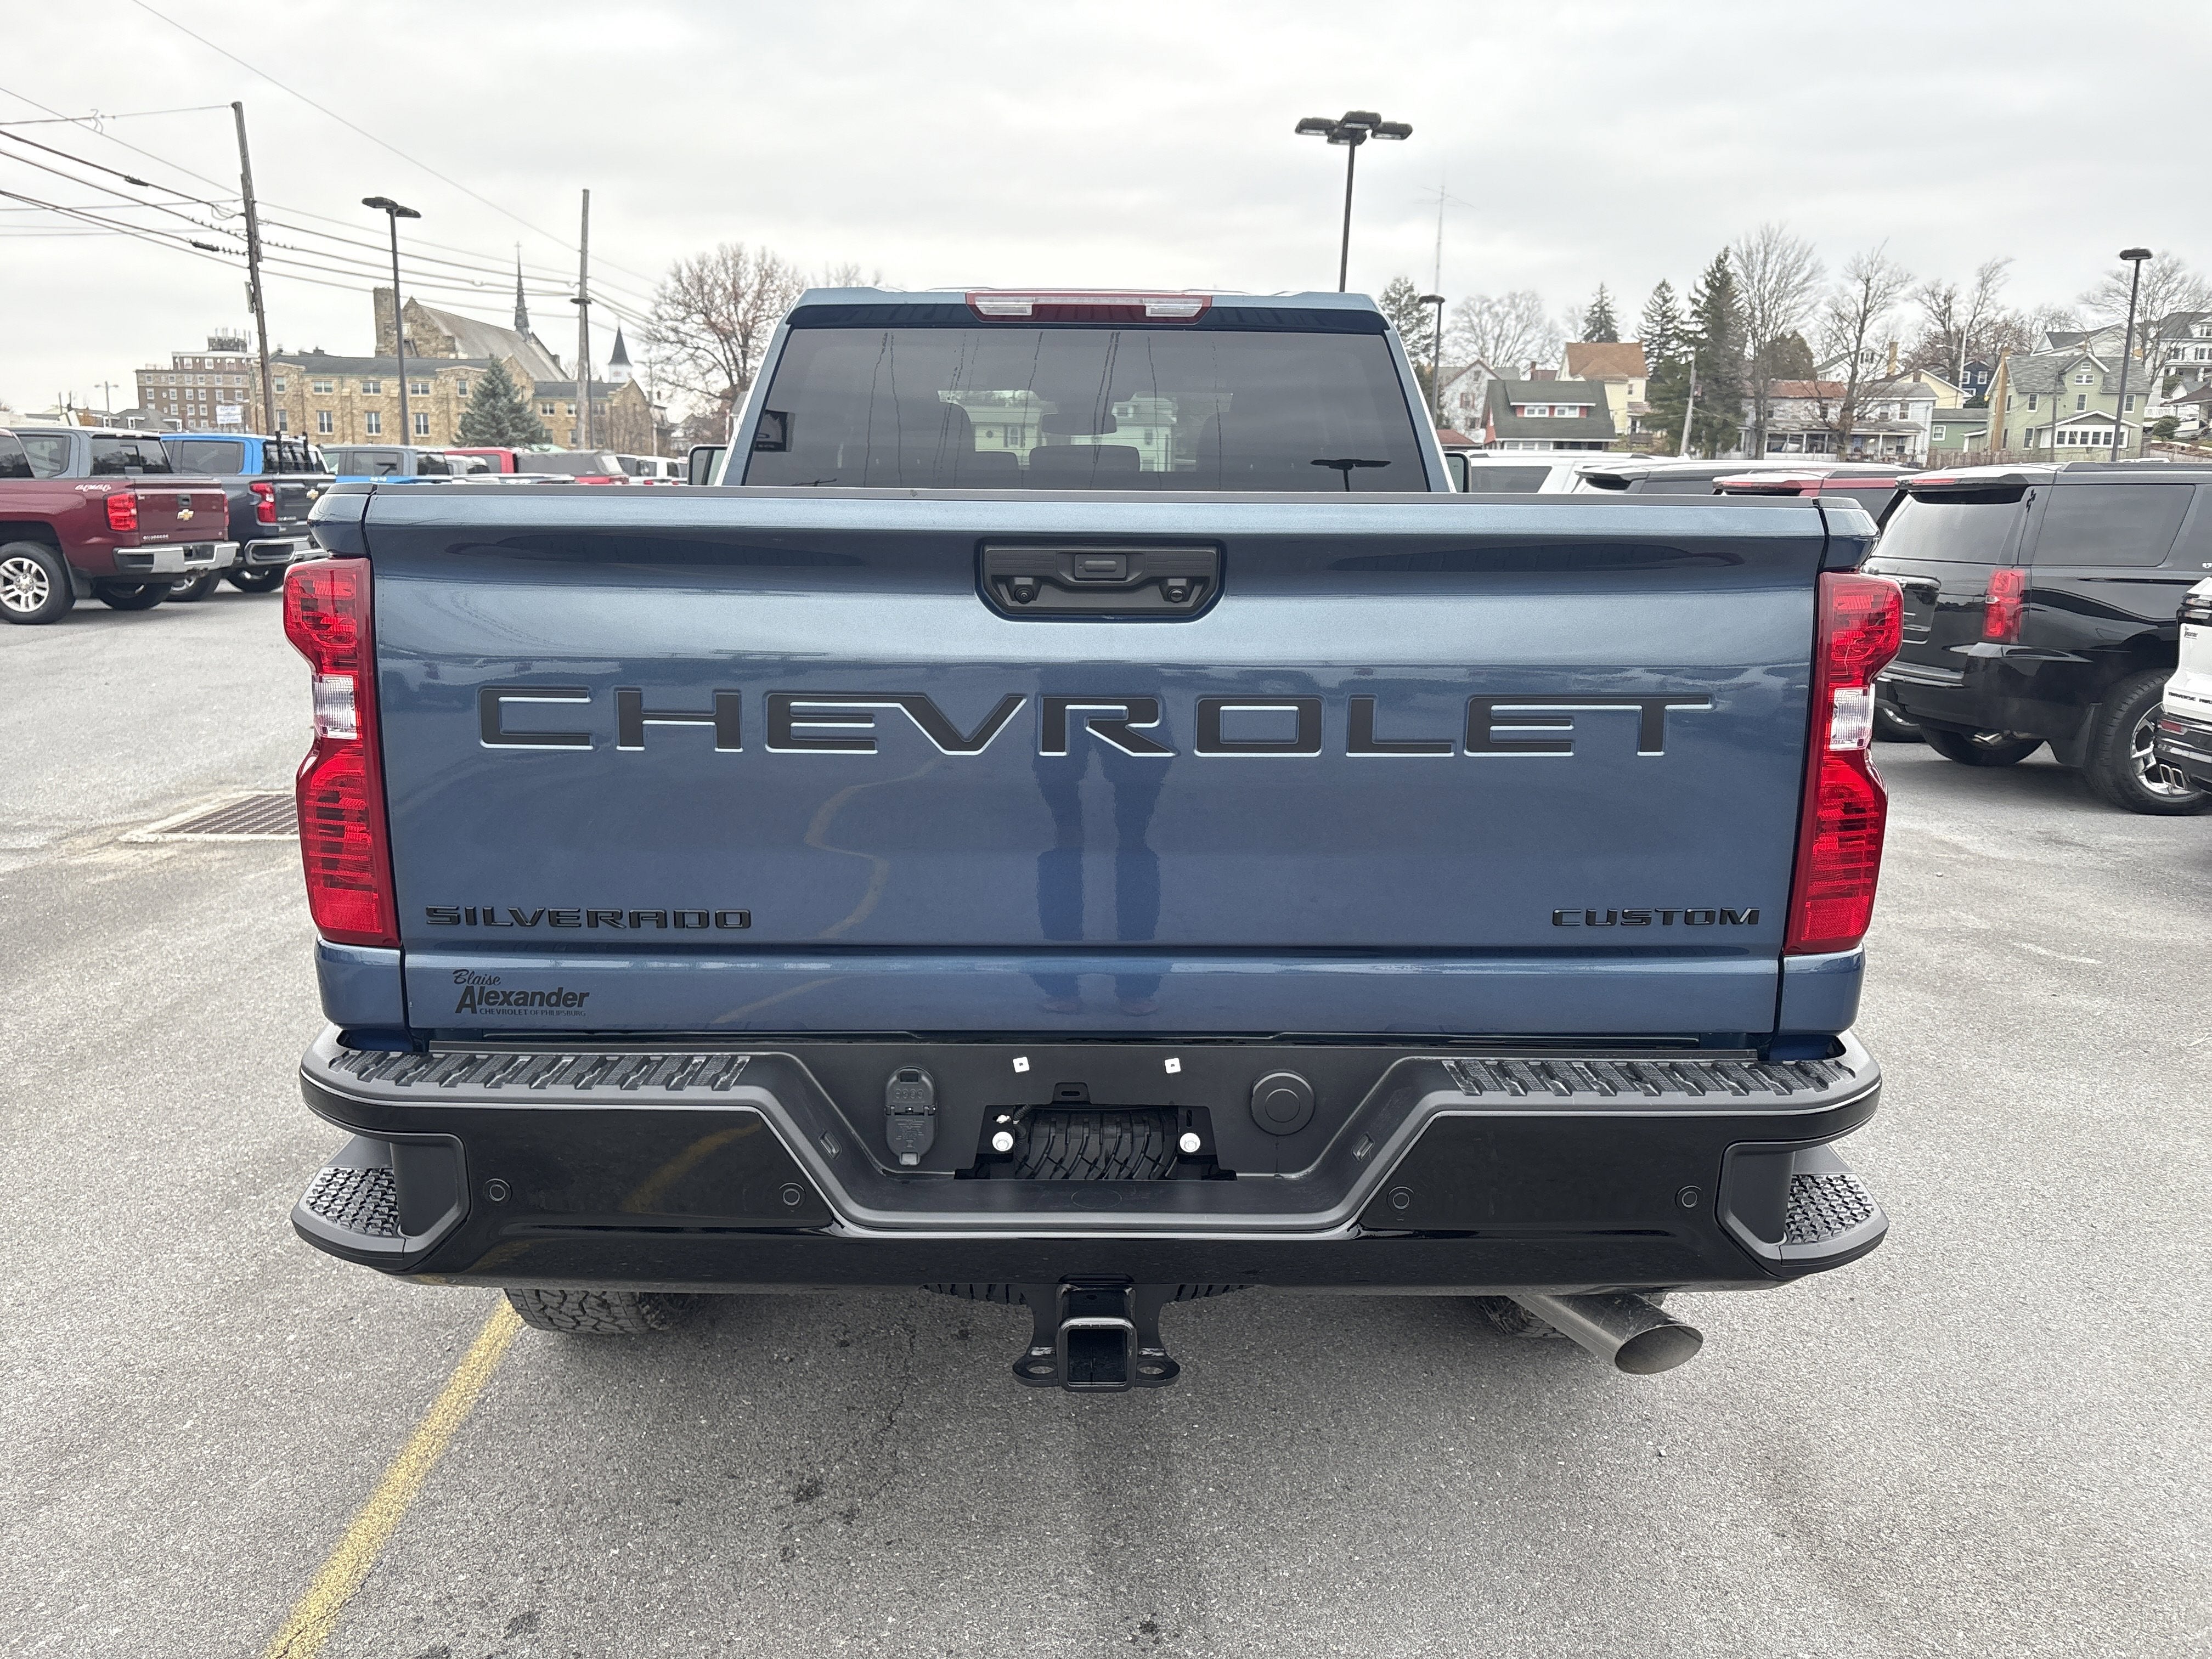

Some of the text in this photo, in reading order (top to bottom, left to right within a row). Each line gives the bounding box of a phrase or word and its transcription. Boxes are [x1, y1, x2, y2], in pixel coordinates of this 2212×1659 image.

[479, 688, 1713, 758] CHEVROLET
[425, 905, 752, 929] SILVERADO
[1552, 907, 1760, 927] CUSTOM
[452, 969, 501, 986] Blaise
[455, 985, 590, 1014] Alexander
